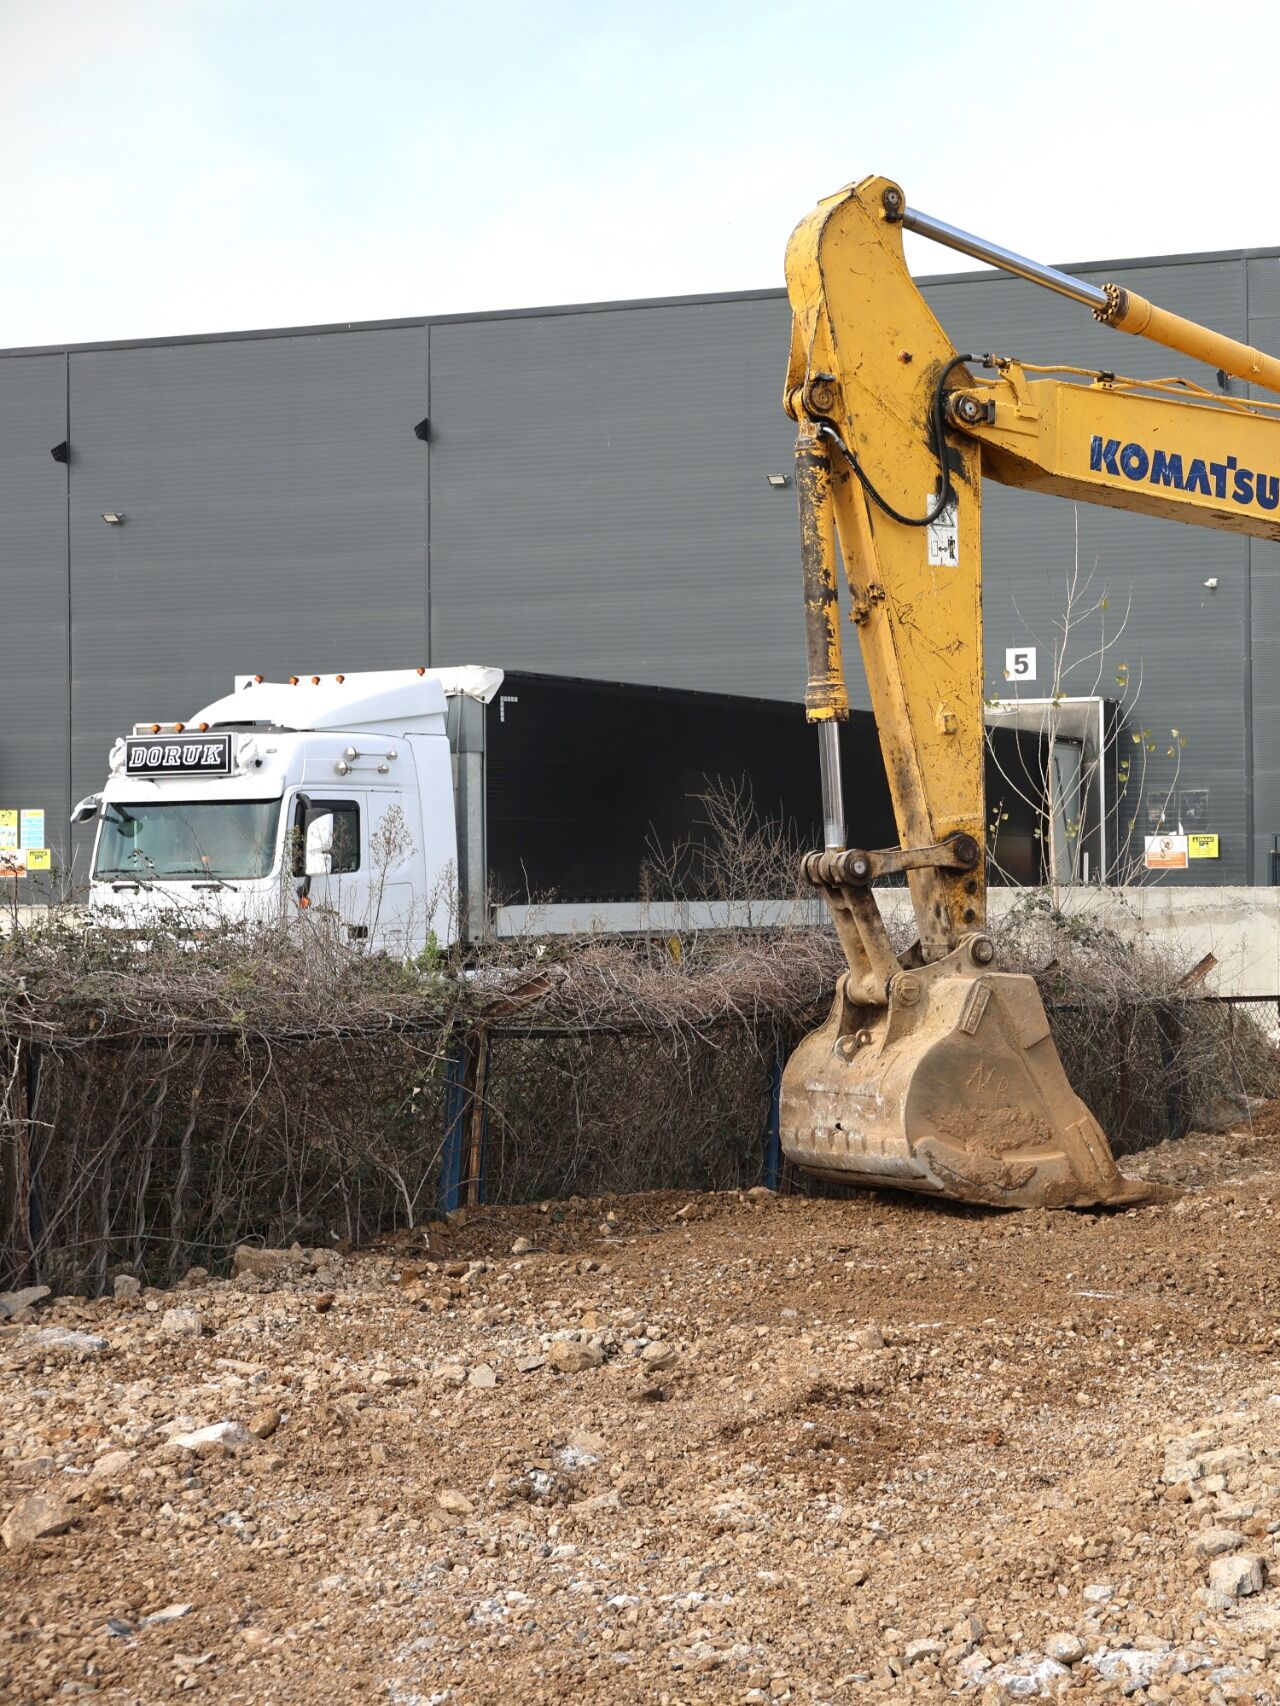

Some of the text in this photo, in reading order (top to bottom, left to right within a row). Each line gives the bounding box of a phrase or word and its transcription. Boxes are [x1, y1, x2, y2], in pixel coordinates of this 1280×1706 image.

[1090, 434, 1280, 510] KOMATSU
[1014, 653, 1029, 675] 5
[129, 744, 224, 767] DORUK
